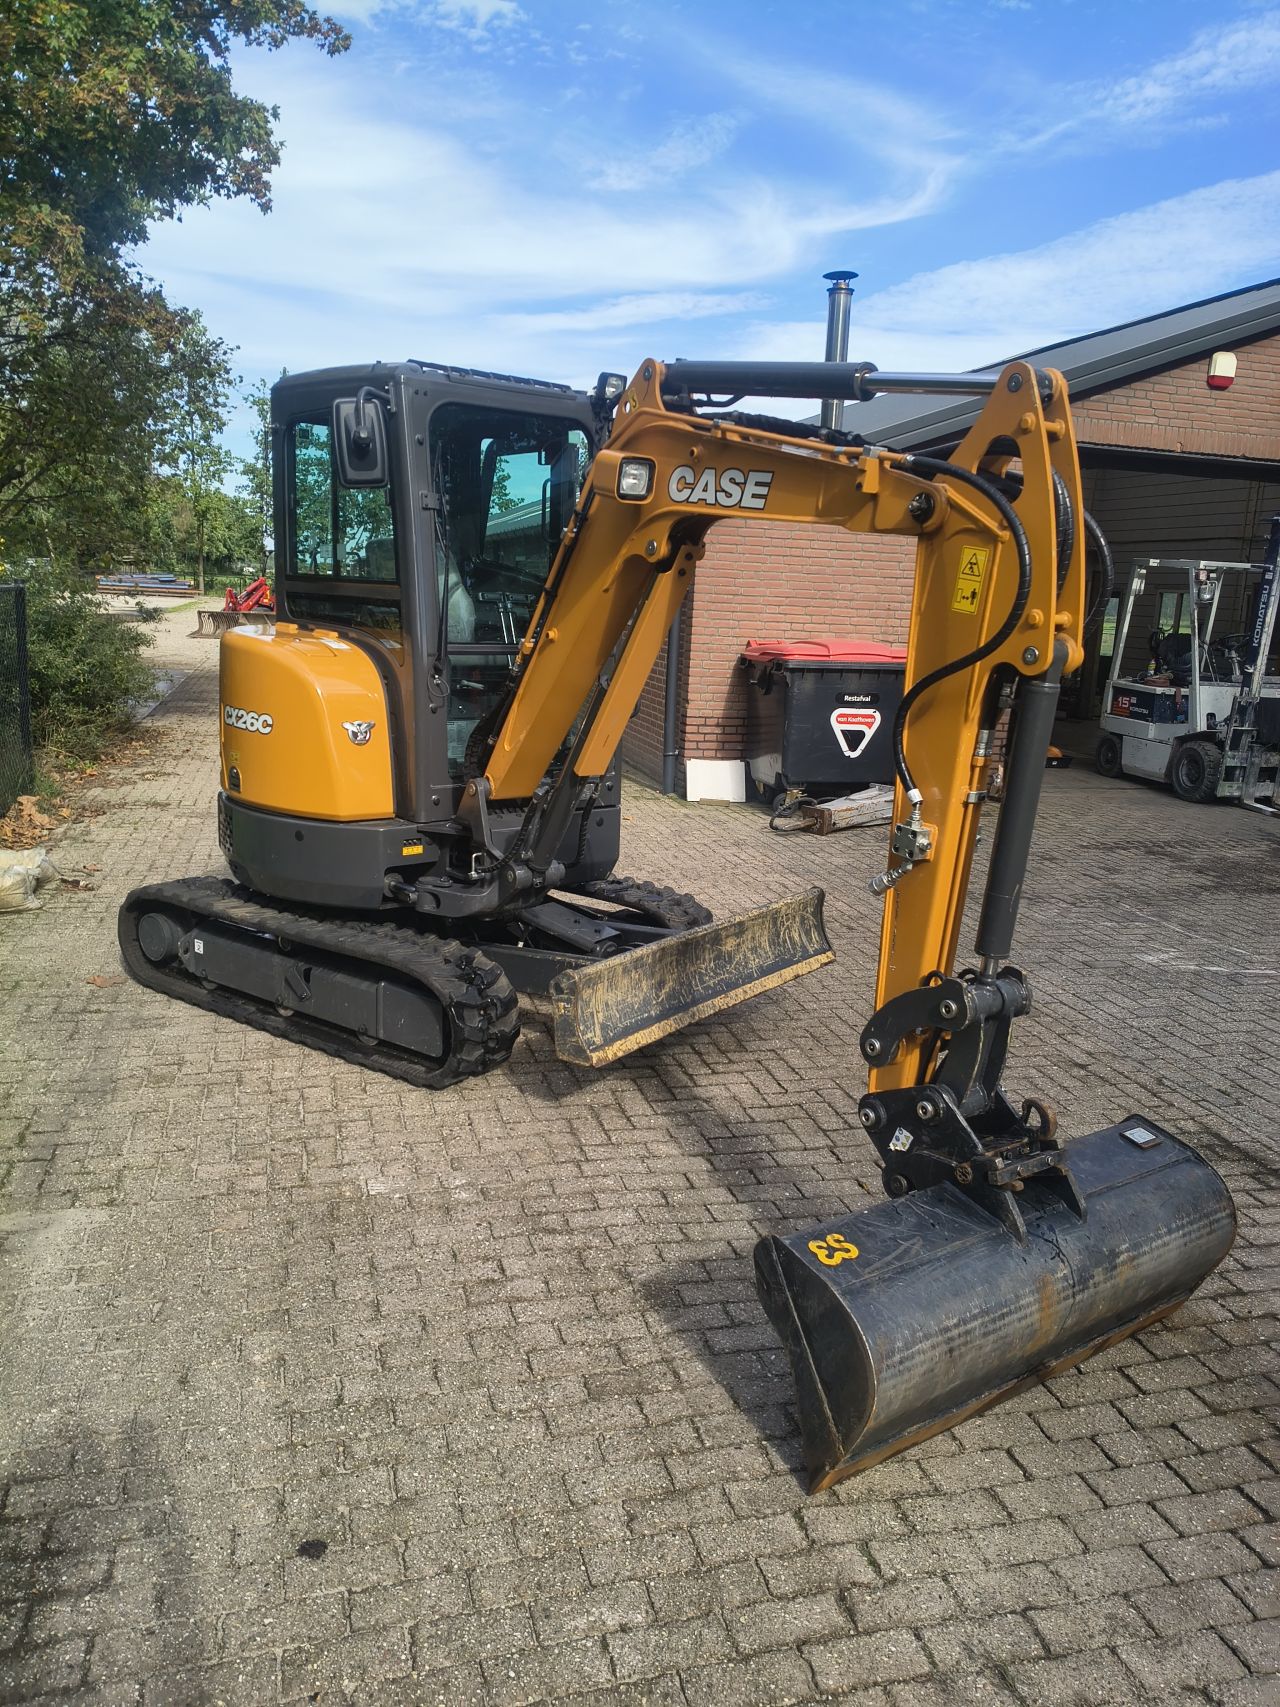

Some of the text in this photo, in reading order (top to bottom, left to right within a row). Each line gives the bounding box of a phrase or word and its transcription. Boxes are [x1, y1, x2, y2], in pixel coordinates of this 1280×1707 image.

[668, 465, 774, 510] CASE
[1252, 585, 1270, 647] KOMATSU
[224, 705, 273, 735] CX26C
